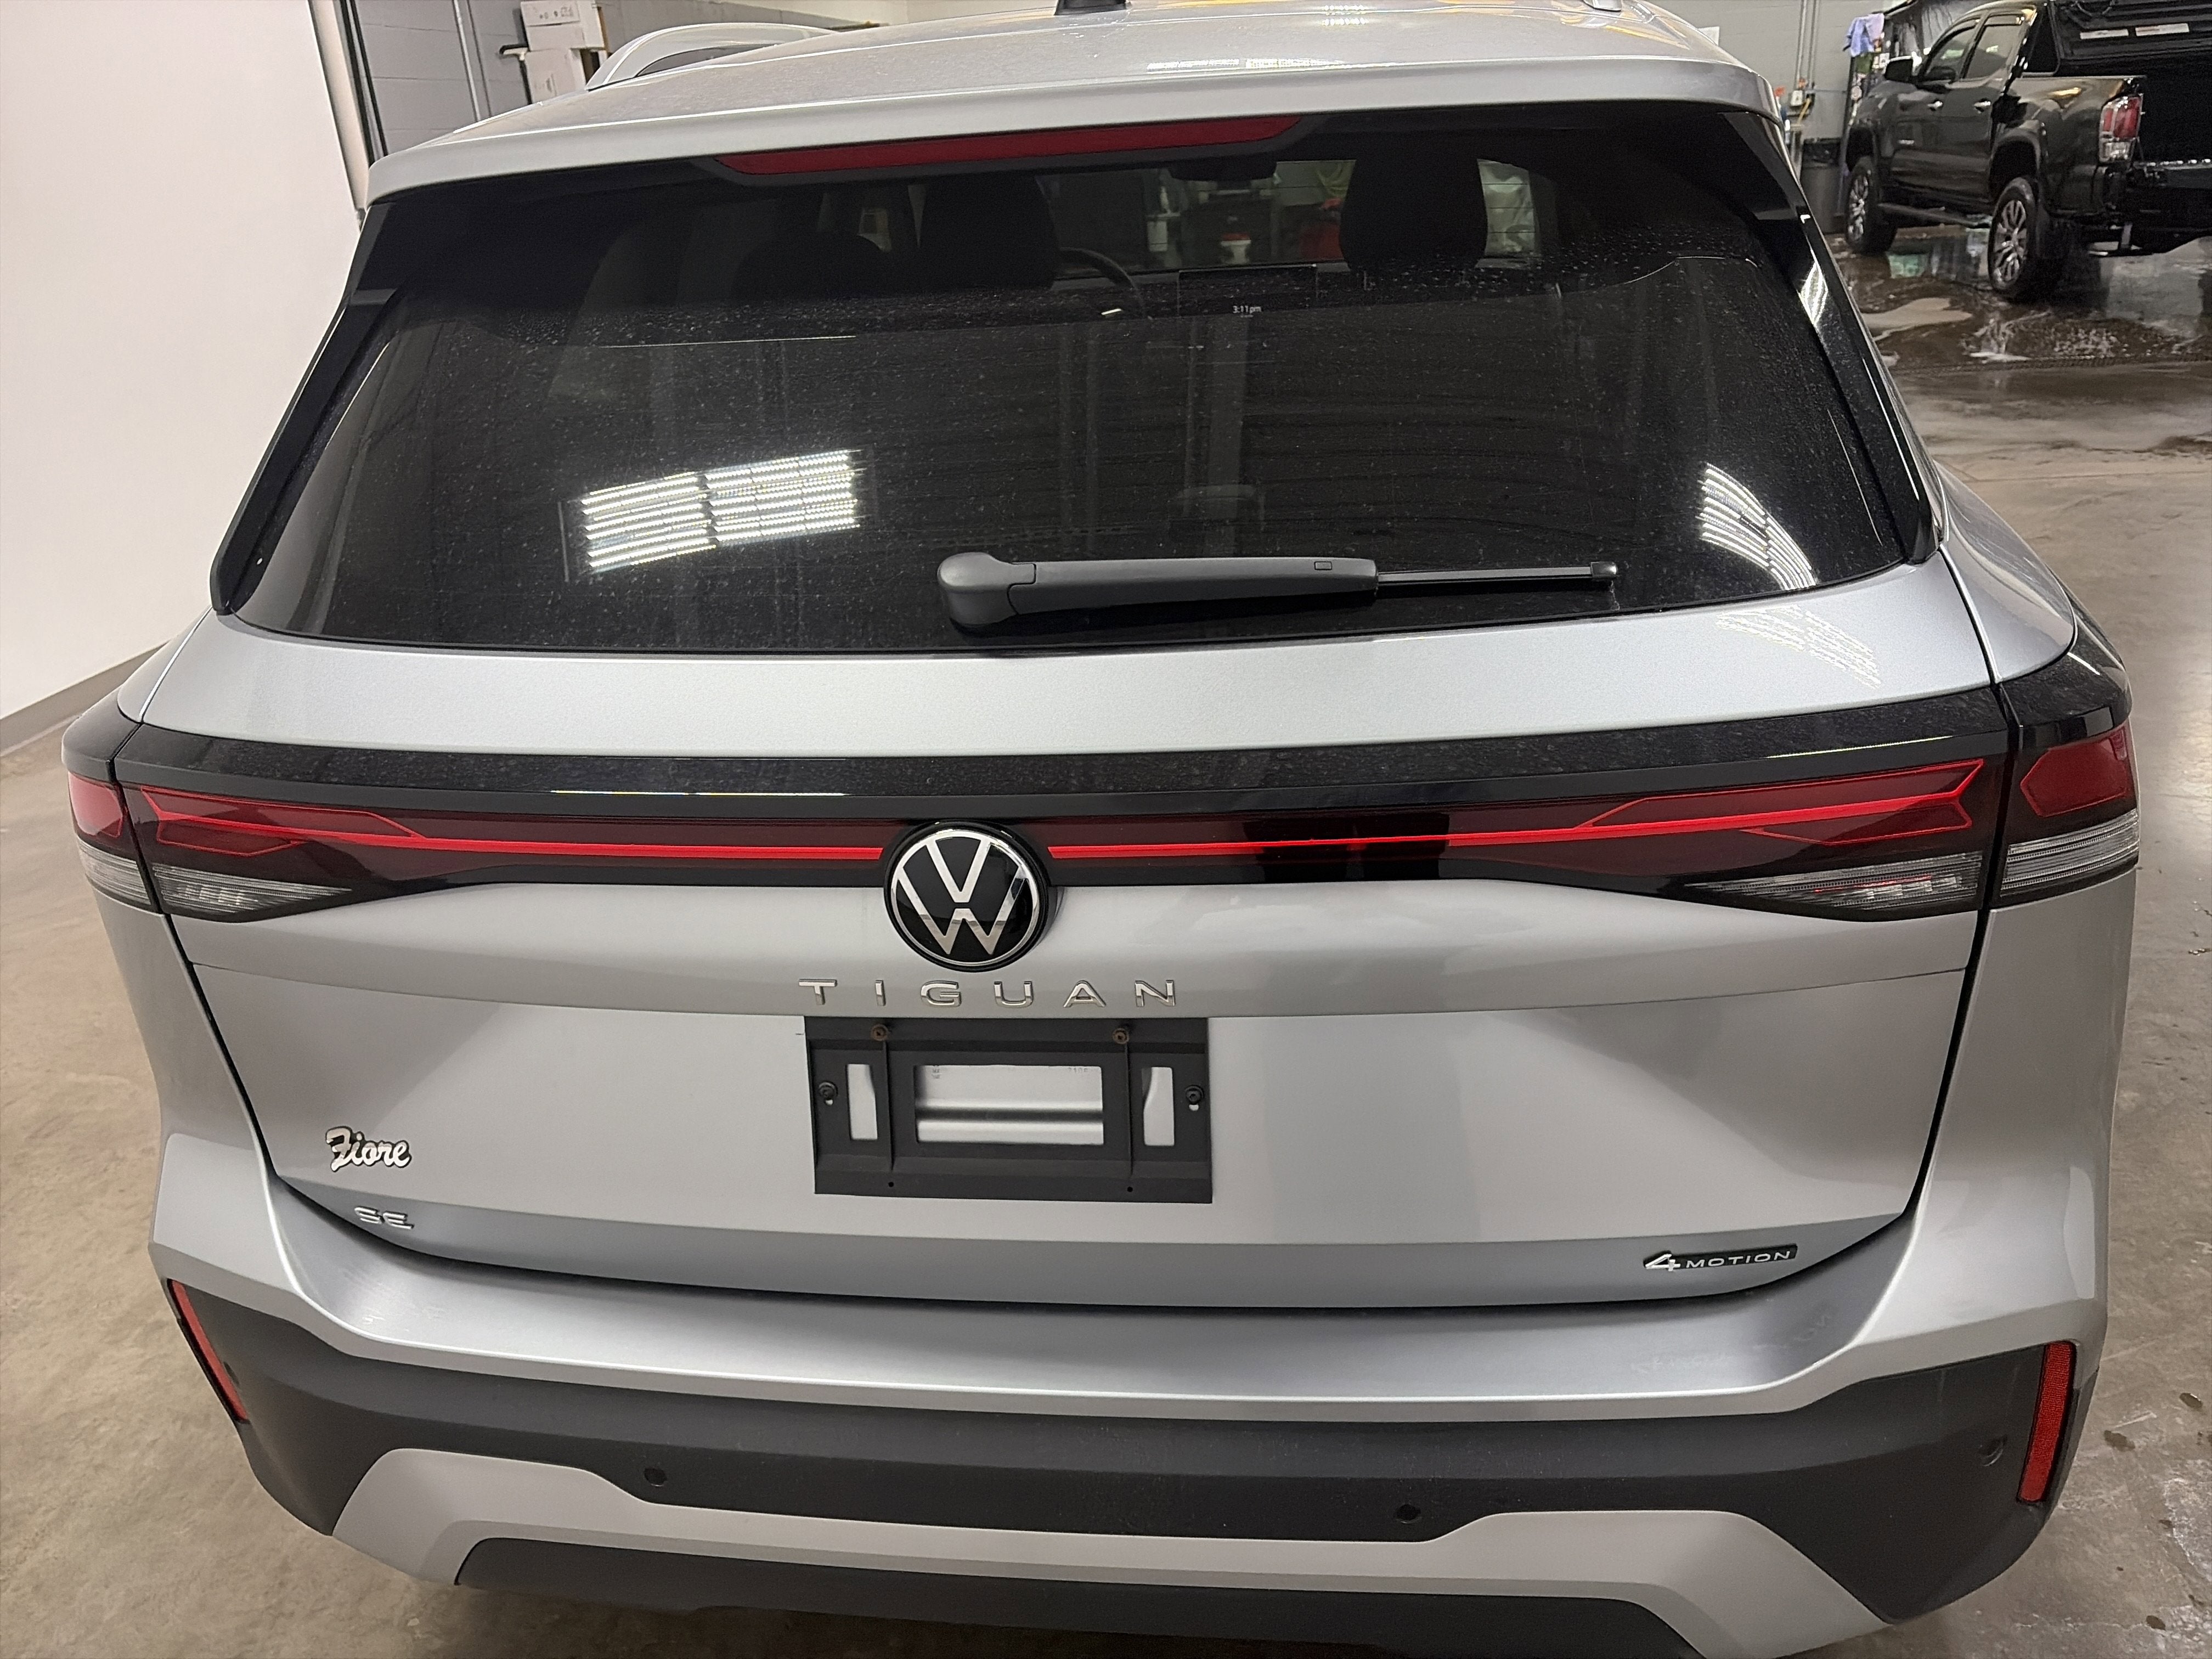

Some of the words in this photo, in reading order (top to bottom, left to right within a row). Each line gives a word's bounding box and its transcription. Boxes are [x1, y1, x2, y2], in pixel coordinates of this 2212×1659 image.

[1233, 305, 1262, 314] 3:11pm
[799, 979, 1176, 1008] TIGUAN
[325, 1126, 412, 1172] Fiore
[354, 1205, 415, 1230] SE
[1645, 1250, 1791, 1272] 4MOTION
